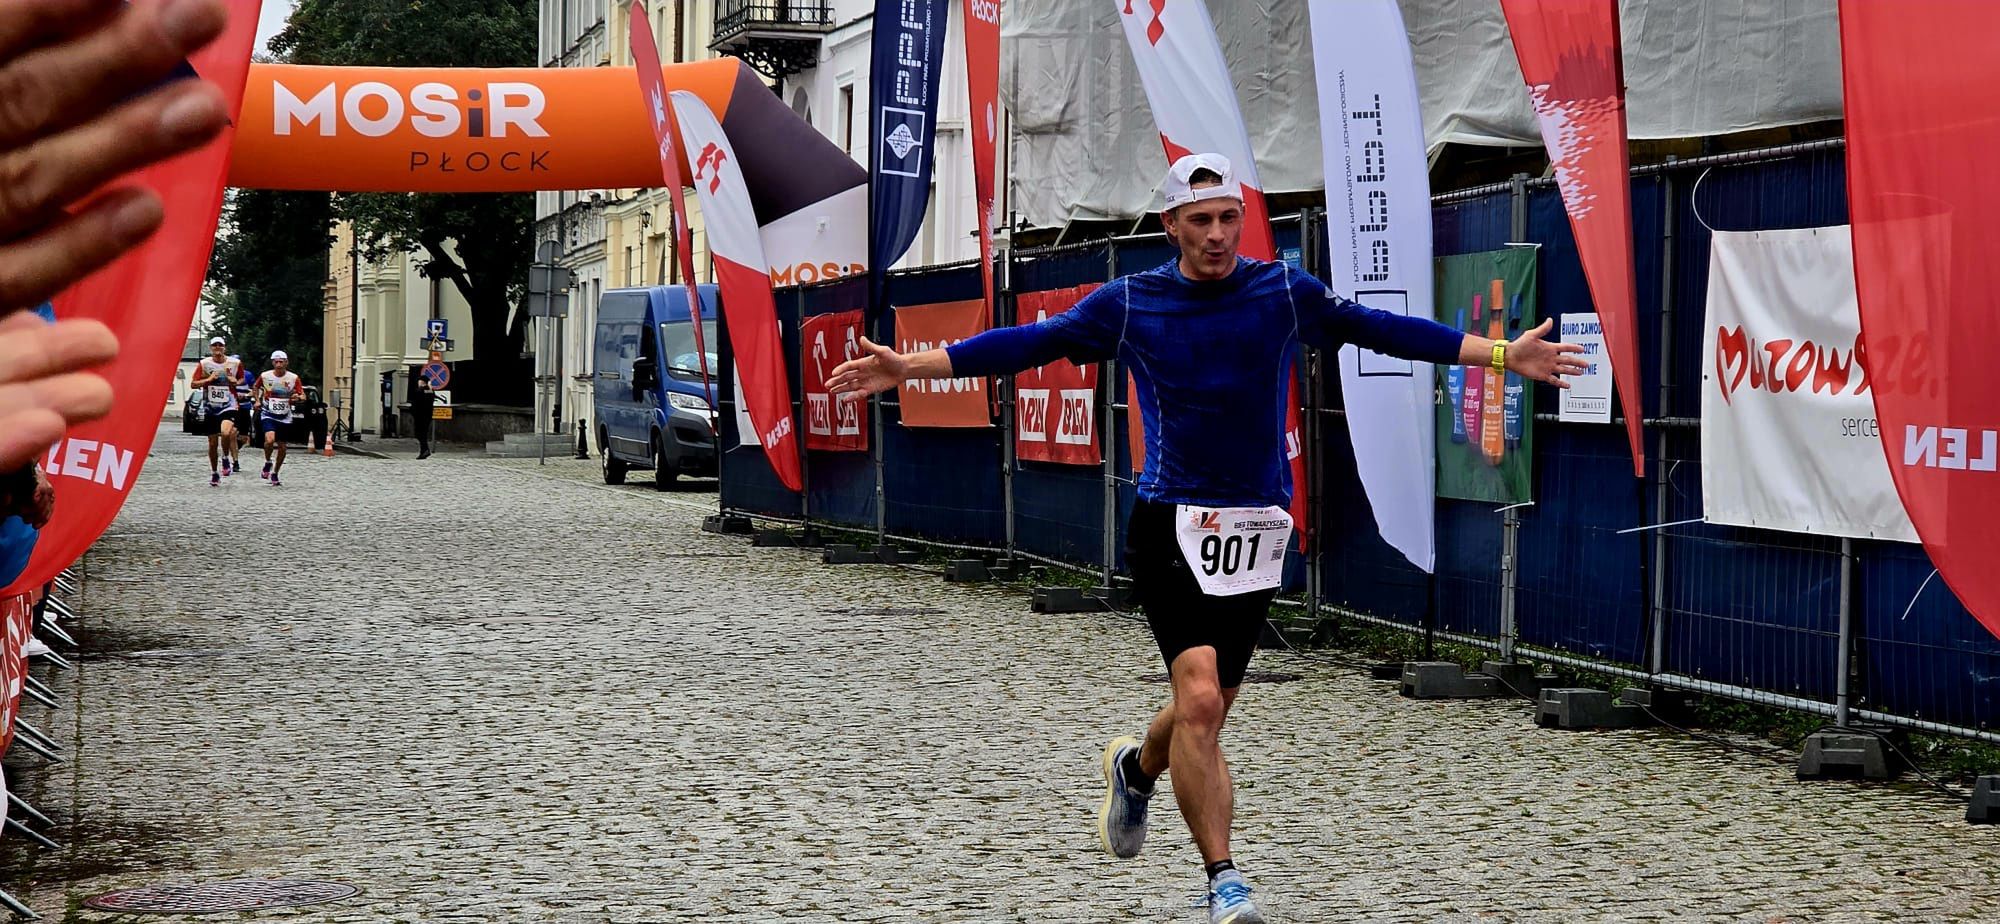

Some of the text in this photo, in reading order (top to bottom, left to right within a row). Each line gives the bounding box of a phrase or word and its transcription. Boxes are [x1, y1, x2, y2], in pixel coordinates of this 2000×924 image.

[273, 79, 551, 138] MOSiR
[410, 151, 550, 172] PŁOCK
[1562, 323, 1579, 335] BIURO
[1842, 416, 1878, 437] serce
[45, 437, 134, 491] LEN
[1201, 533, 1262, 577] 901
